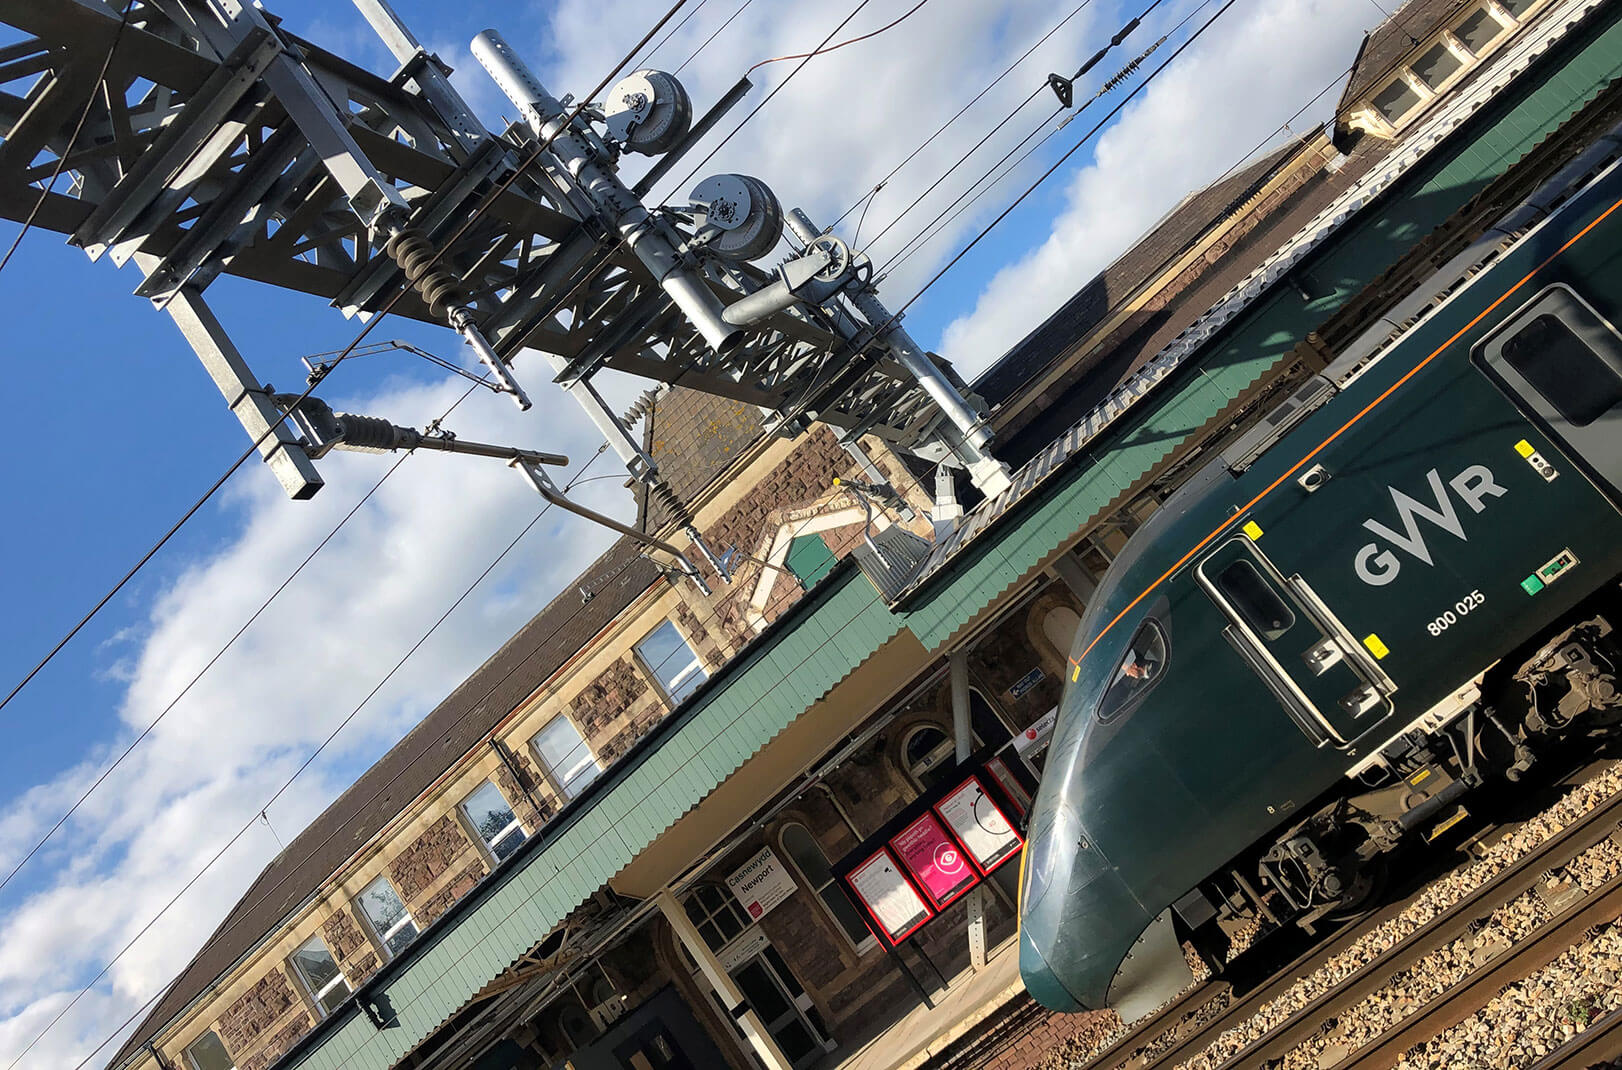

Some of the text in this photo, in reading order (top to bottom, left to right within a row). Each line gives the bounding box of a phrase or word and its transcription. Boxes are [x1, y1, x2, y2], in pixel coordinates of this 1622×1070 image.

[1354, 464, 1509, 586] GWR
[1427, 589, 1486, 637] 800 025
[1266, 805, 1276, 814] 8
[728, 849, 771, 887] Casnewydd
[741, 864, 774, 894] Newport
